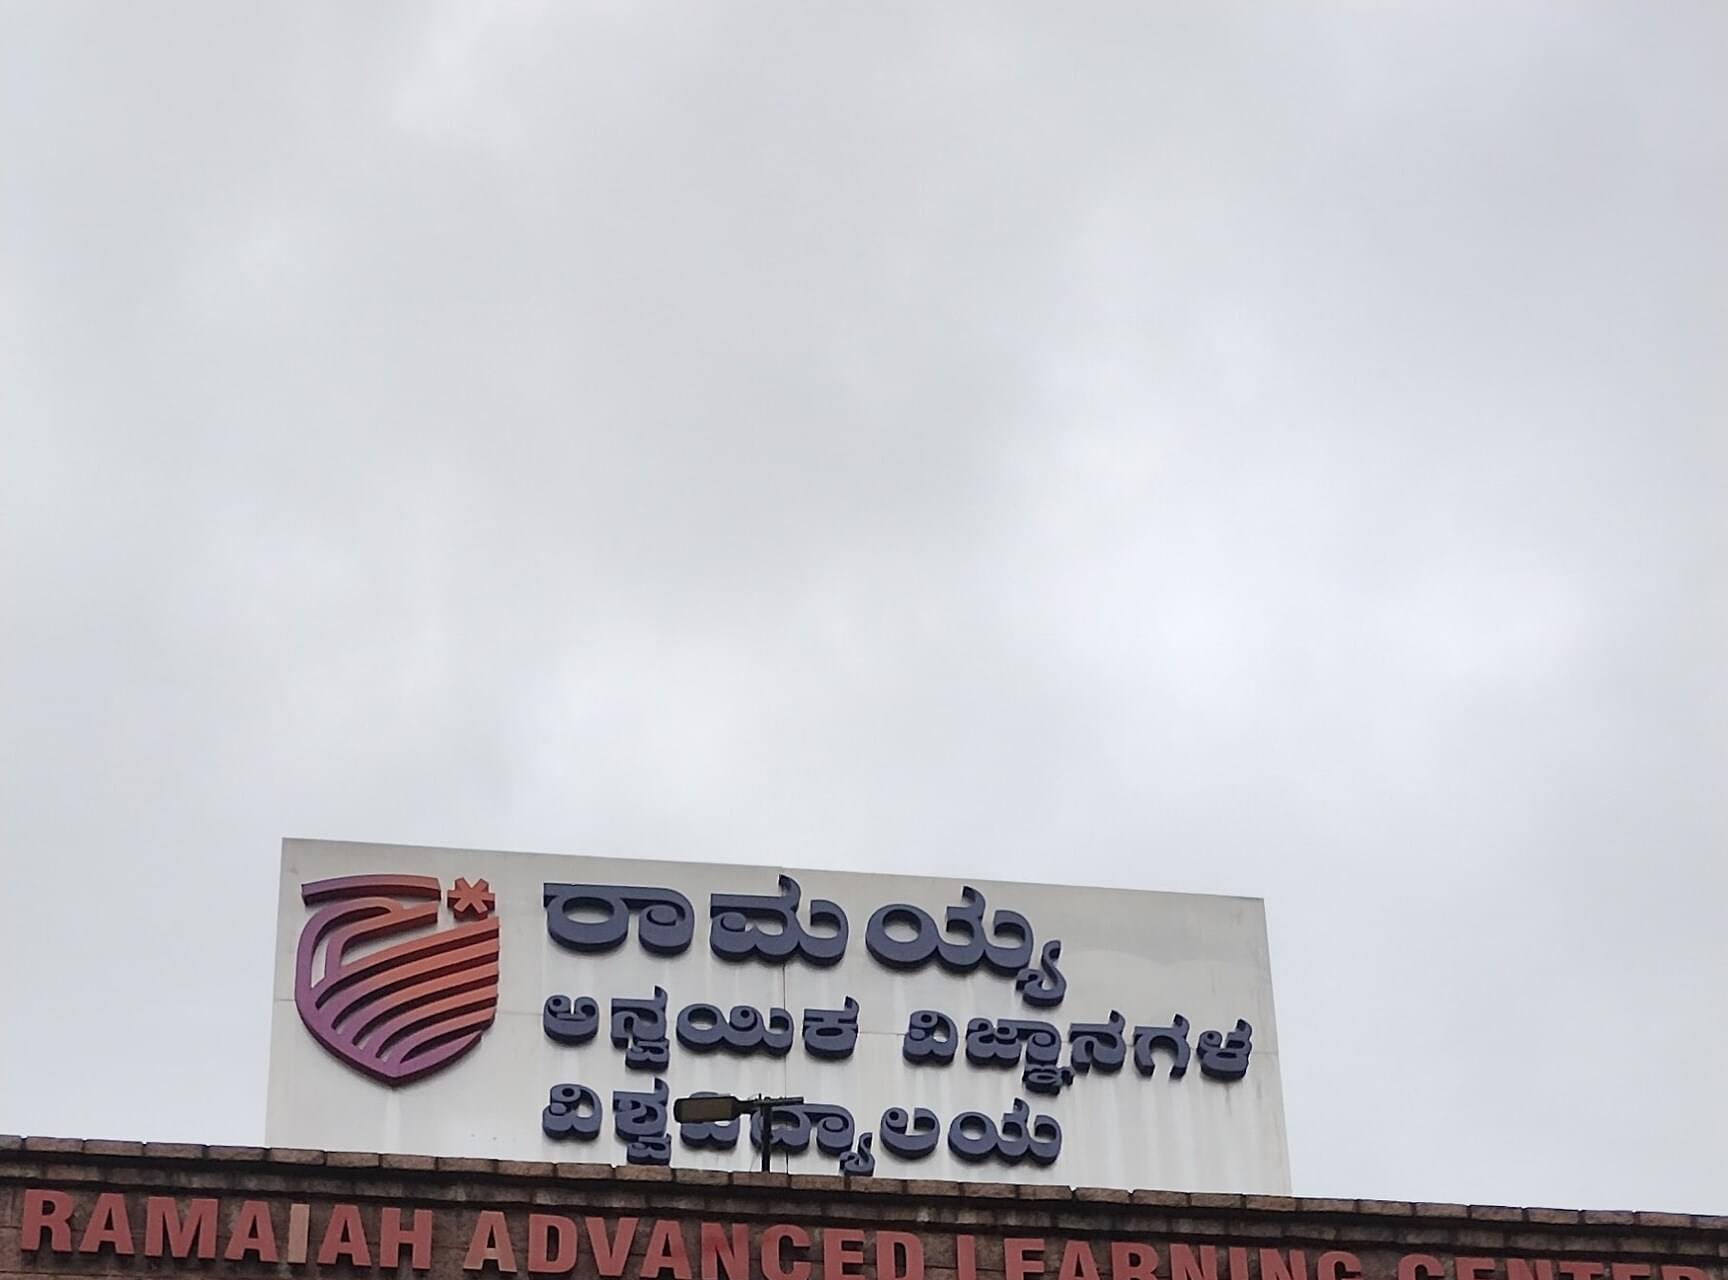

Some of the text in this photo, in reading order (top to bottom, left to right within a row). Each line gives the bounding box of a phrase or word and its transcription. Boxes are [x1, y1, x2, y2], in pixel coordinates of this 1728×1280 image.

[543, 873, 1067, 1007] ರಾಮಯ್ಯ
[542, 985, 1253, 1096] ಅನ್ವಯಿಕ ವಿಜ್ಞಾನಗಳ
[20, 1188, 434, 1270] RAMAIAH
